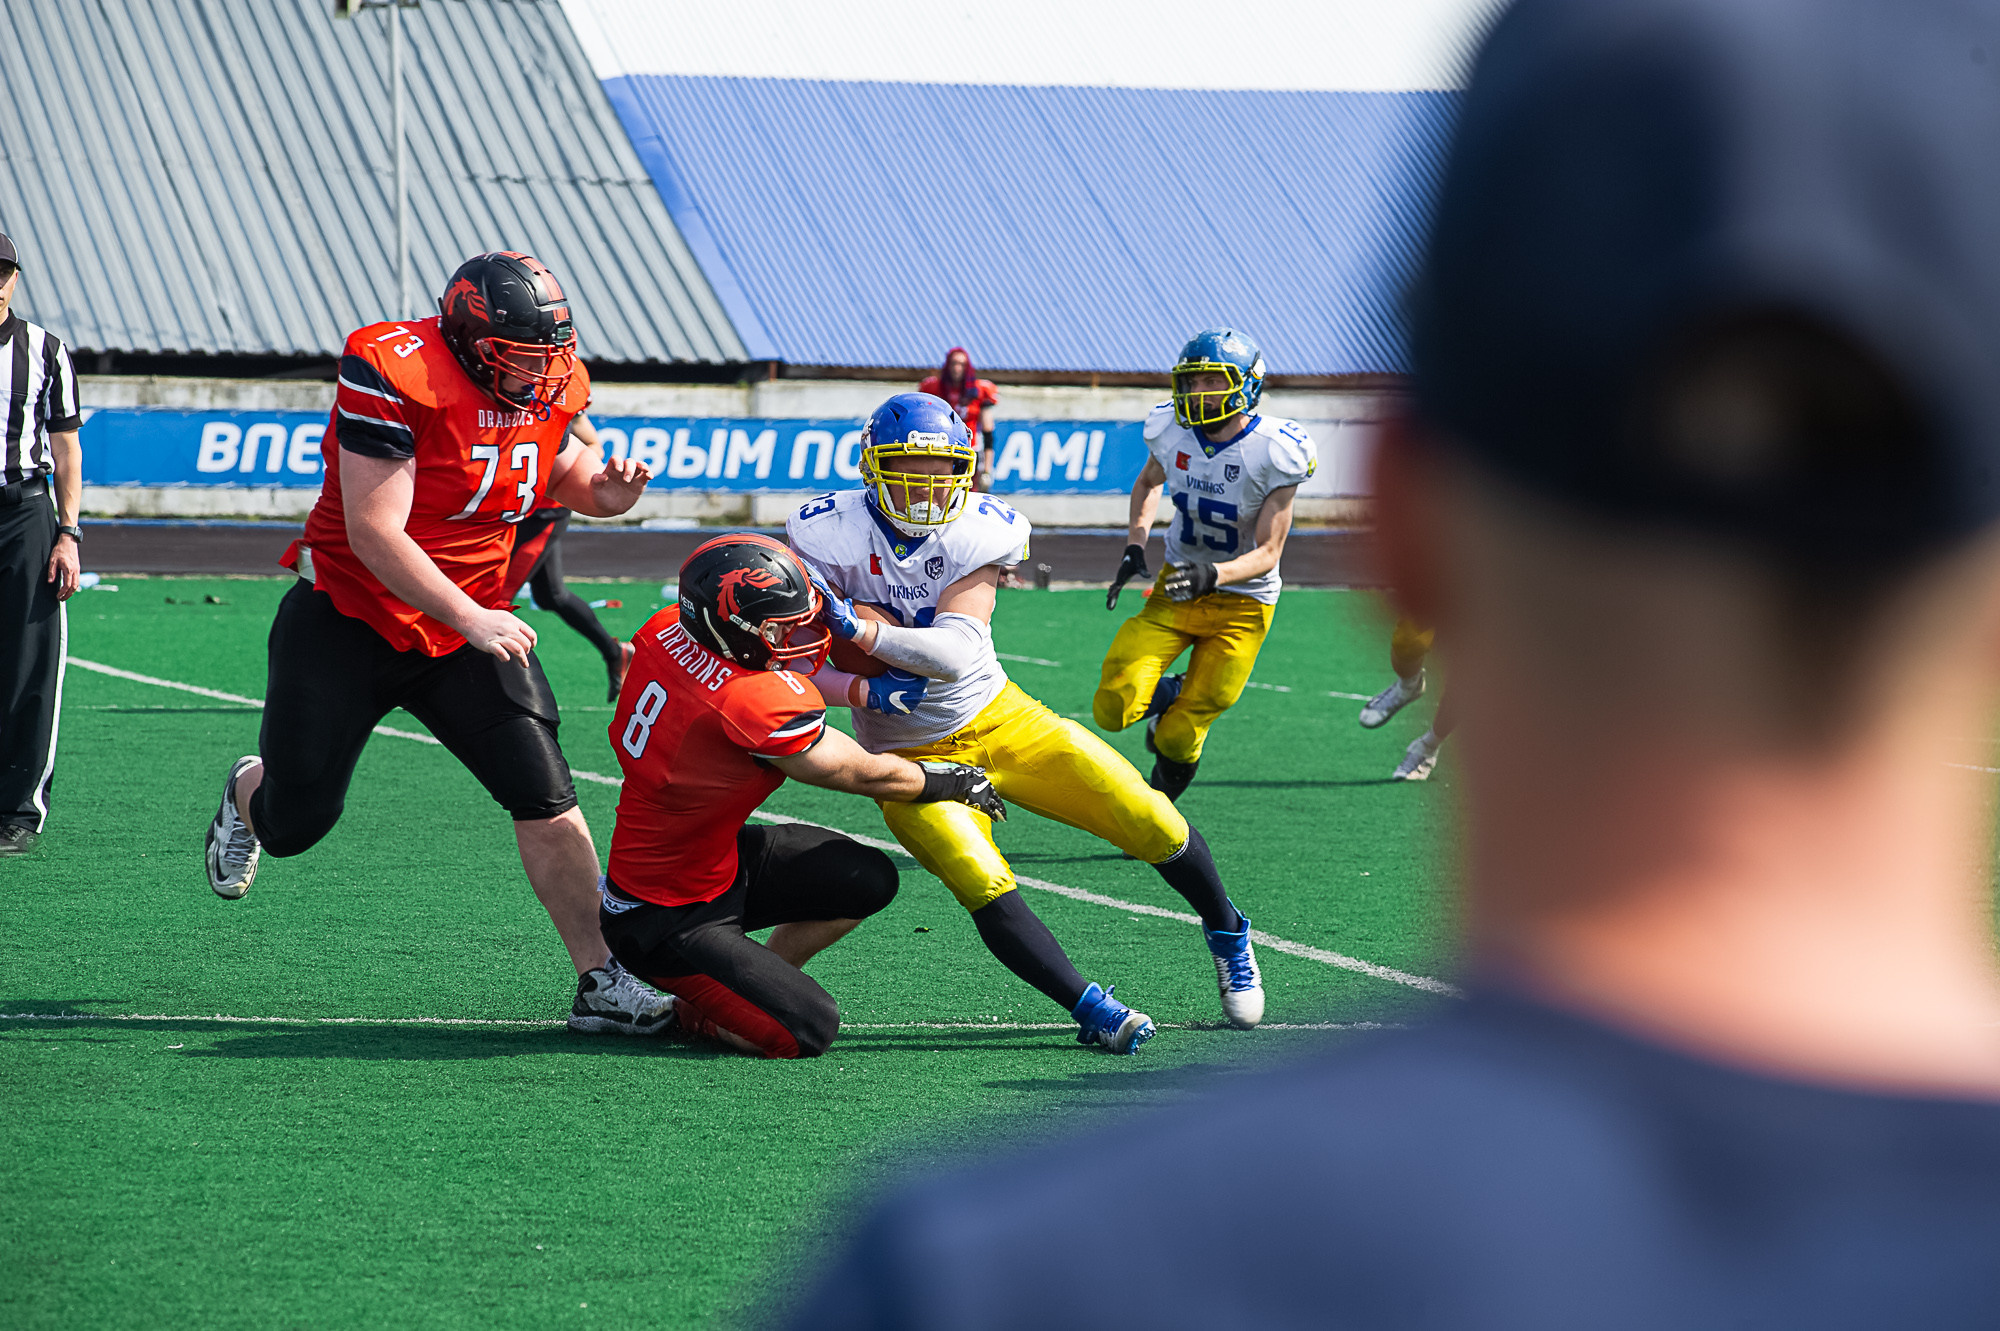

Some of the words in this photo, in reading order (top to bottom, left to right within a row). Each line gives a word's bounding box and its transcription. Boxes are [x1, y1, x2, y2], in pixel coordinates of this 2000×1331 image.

[376, 325, 424, 358] 73
[197, 421, 328, 474] ВПЕ
[478, 409, 534, 428] DRAGONS
[445, 442, 539, 523] 73
[1186, 474, 1225, 495] VIKINGS
[1172, 491, 1239, 554] 15
[656, 622, 733, 691] DRAGONS
[622, 679, 668, 760] 8
